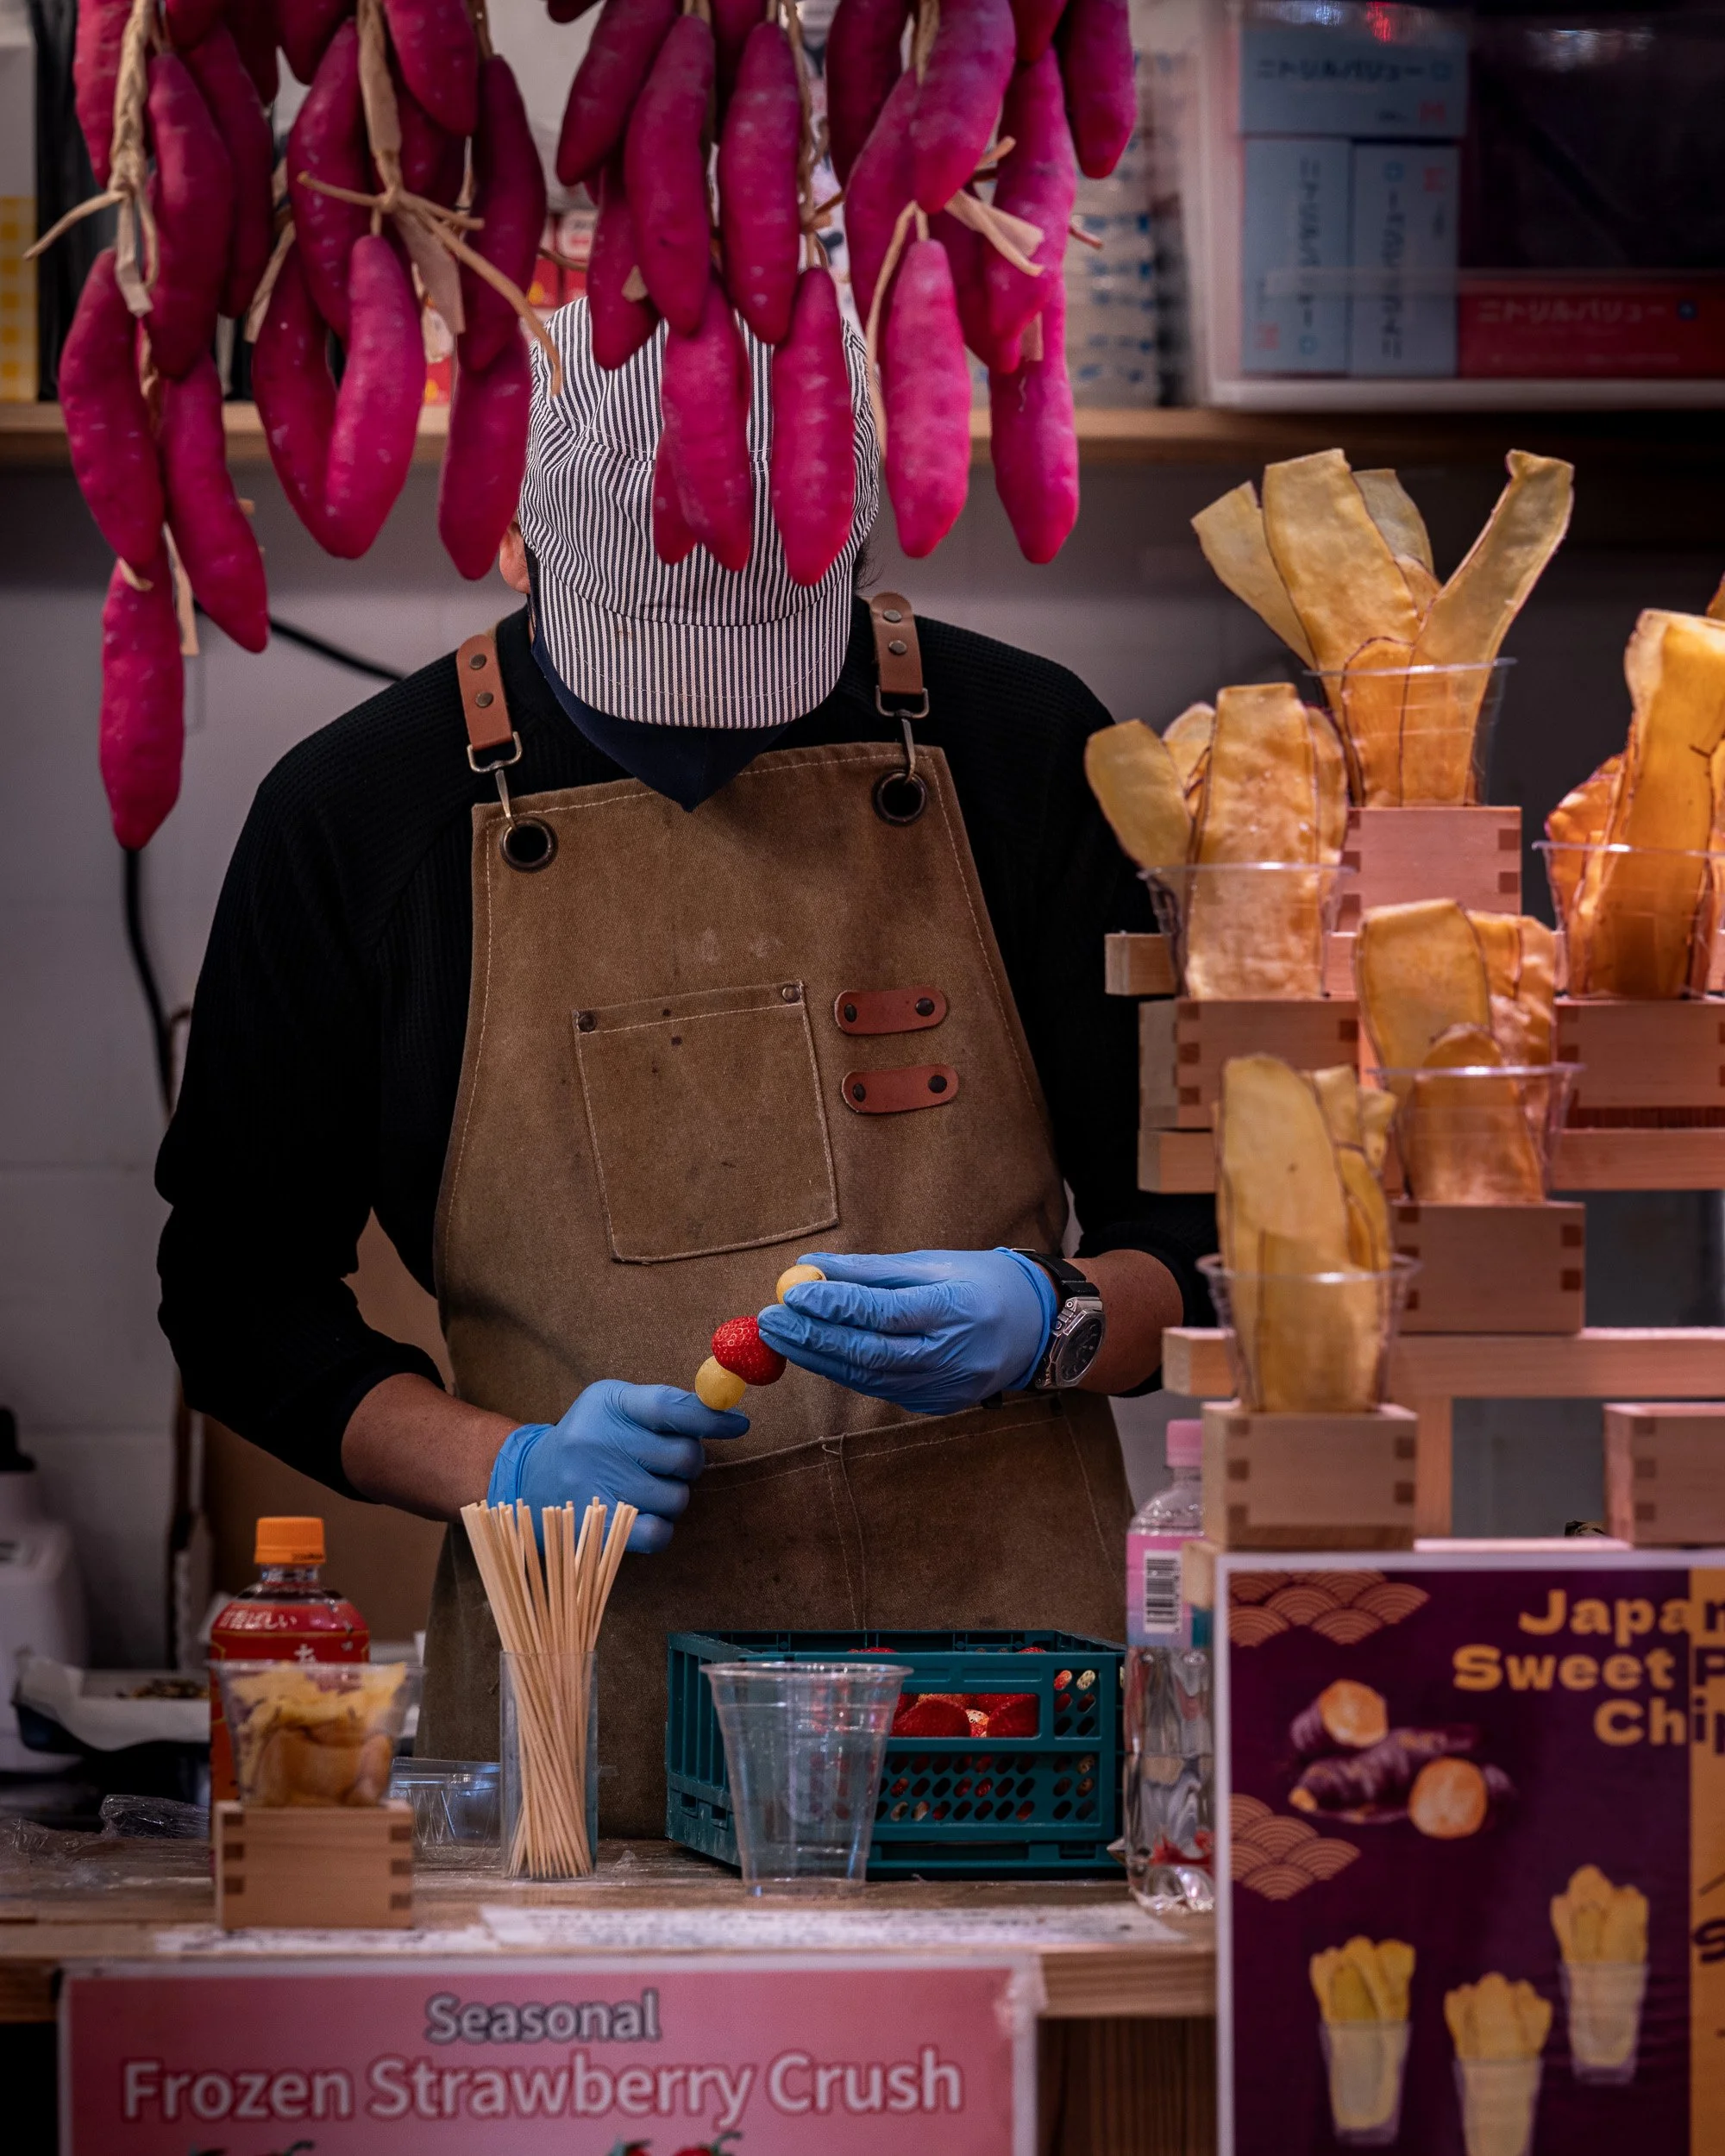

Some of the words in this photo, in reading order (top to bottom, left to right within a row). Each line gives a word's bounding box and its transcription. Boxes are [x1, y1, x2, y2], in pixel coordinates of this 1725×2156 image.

[1452, 1644, 1676, 1691] Sweet
[427, 1991, 660, 2043] Seasonal
[123, 2059, 351, 2120] Frozen
[370, 2049, 756, 2129] Strawberry
[768, 2045, 963, 2114] Crush
